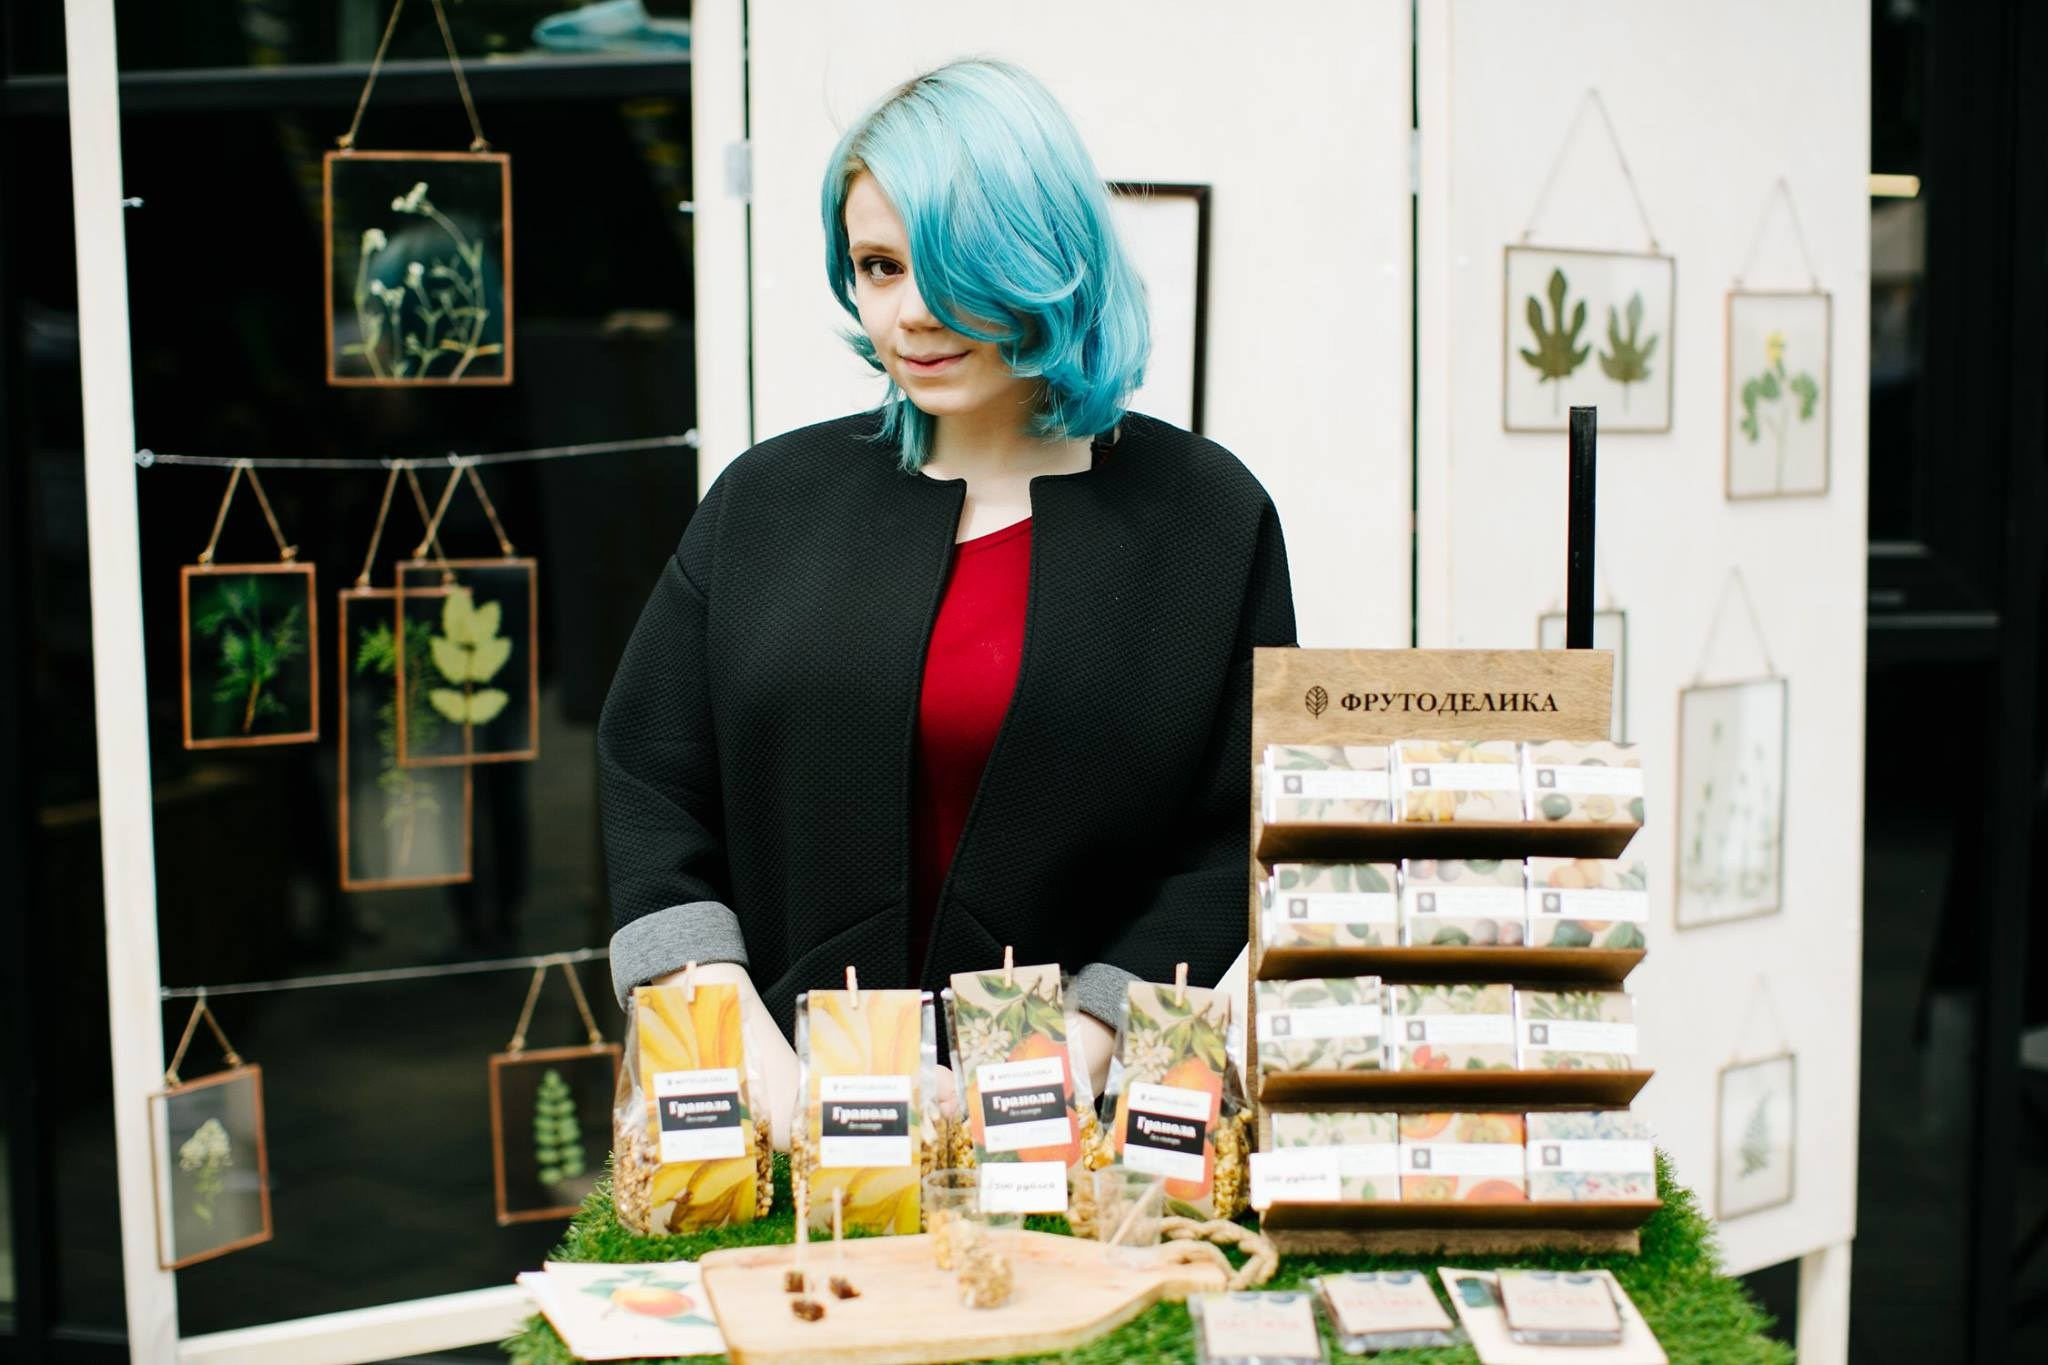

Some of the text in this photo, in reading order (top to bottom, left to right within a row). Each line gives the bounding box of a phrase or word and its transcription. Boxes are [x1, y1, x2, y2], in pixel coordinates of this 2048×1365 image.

[1340, 692, 1559, 717] ФРУТОДЕЛИКА
[668, 1100, 731, 1119] Гранола
[992, 1092, 1056, 1113] Гранола
[832, 1106, 899, 1125] Гранола
[1137, 1116, 1197, 1139] Гранола
